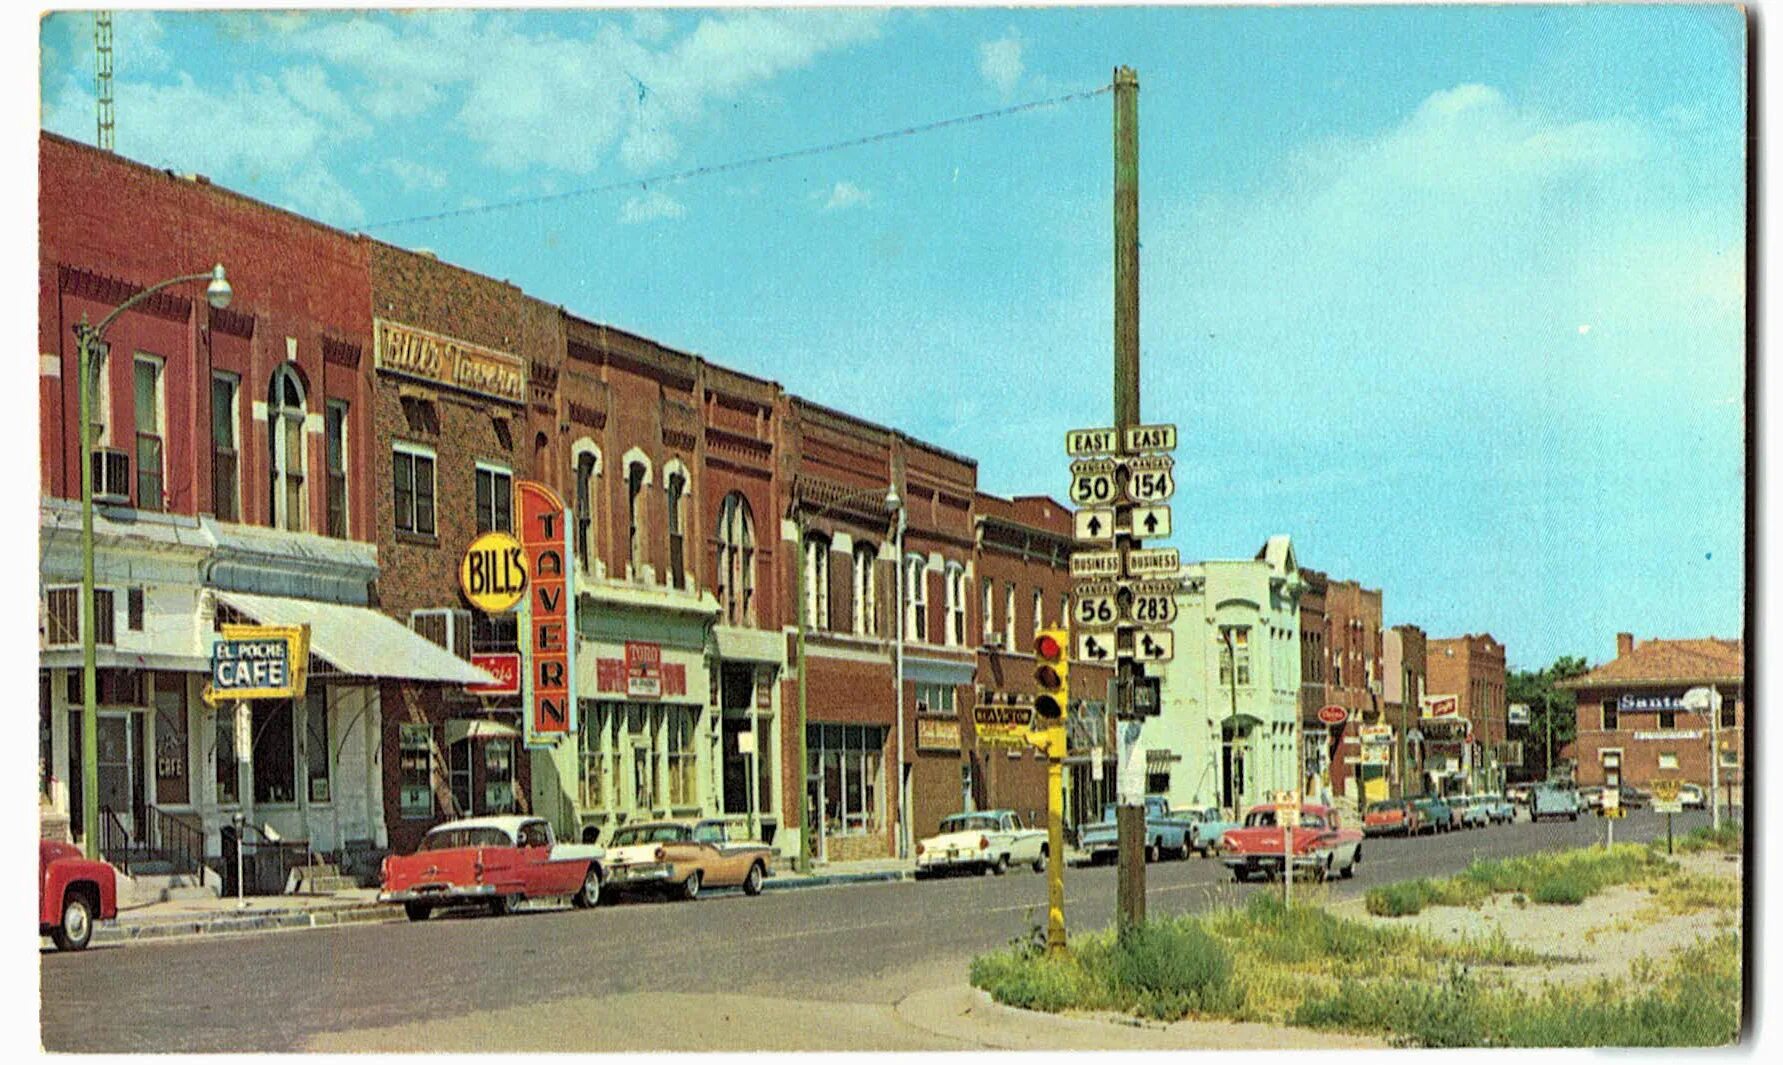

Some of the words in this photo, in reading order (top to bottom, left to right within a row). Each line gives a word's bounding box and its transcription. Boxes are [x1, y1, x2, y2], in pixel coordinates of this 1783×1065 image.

[1075, 431, 1109, 450] EAST
[1133, 430, 1168, 448] EAST
[1076, 462, 1112, 472] KANSAS
[1132, 456, 1171, 470] KANSAS
[1079, 477, 1109, 500] 50
[1136, 473, 1166, 497] 154
[1074, 556, 1118, 572] BUSINESS
[1131, 554, 1176, 570] BUSINESS
[469, 547, 526, 597] BILL'S
[1136, 582, 1172, 593] KANSAS
[1082, 599, 1111, 622] 56
[1138, 597, 1168, 620] 283
[537, 511, 566, 725] TAVERN
[217, 643, 233, 659] EL
[217, 660, 284, 687] CAFE
[159, 758, 182, 776] CAFE
